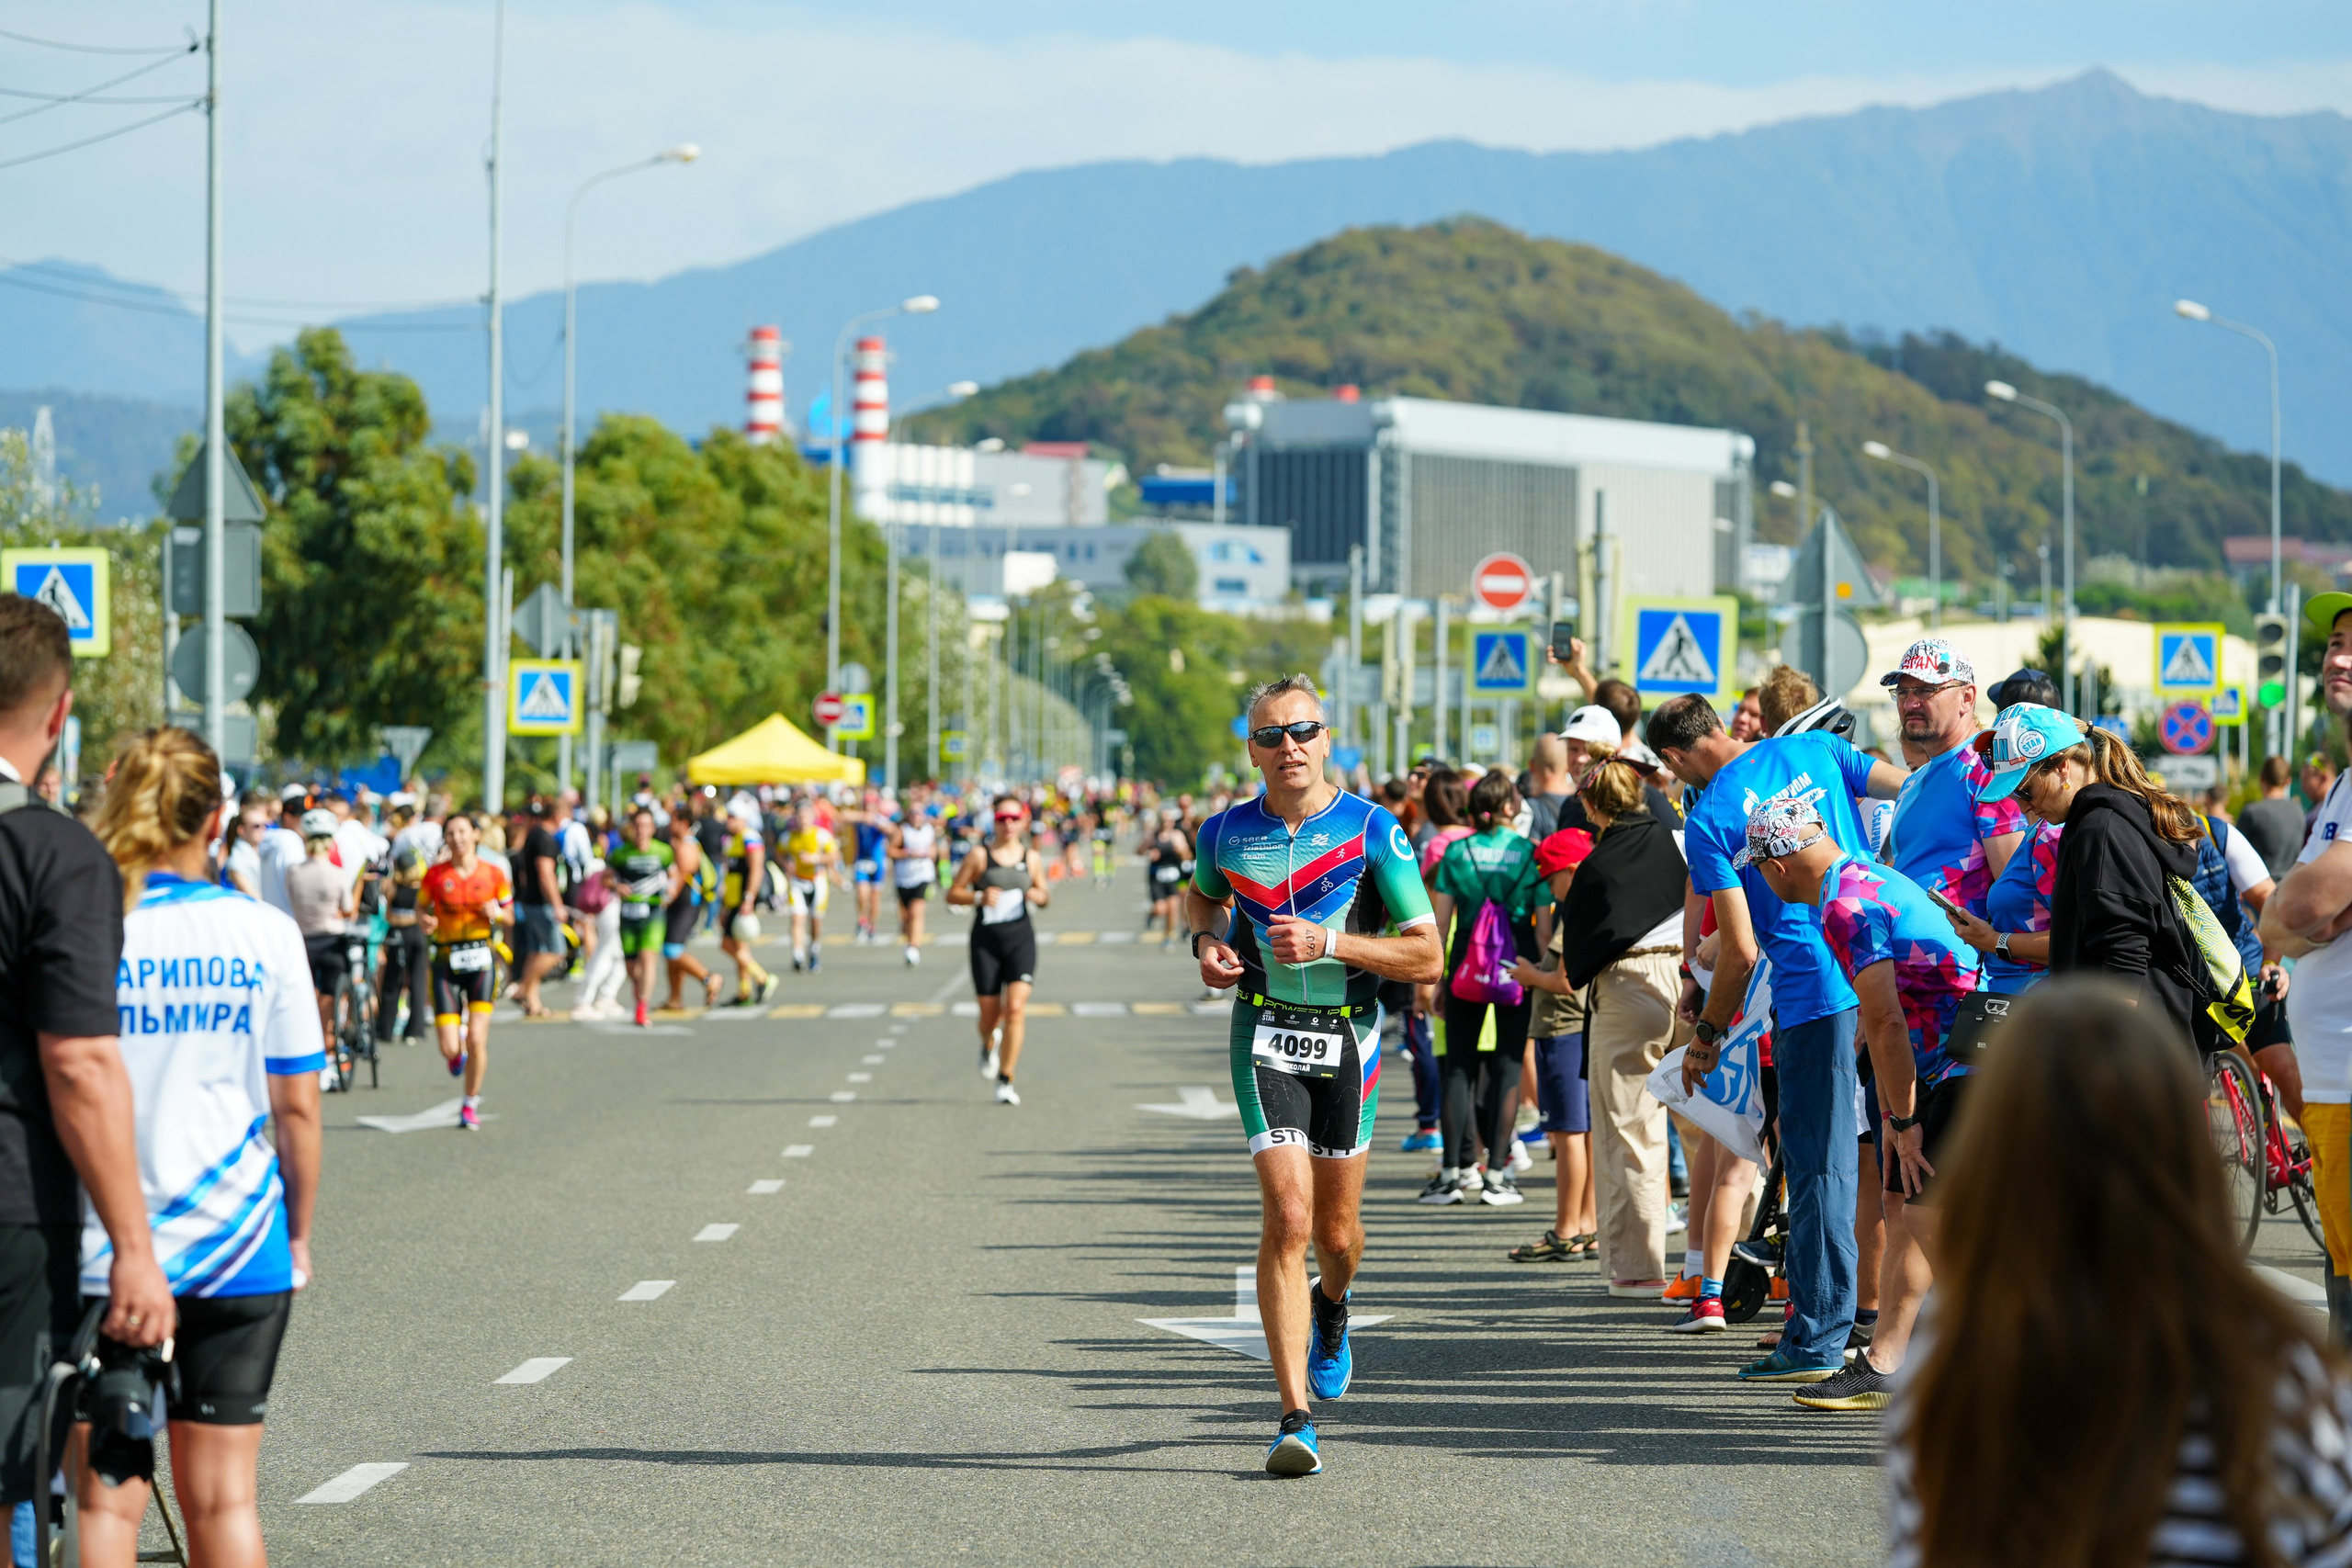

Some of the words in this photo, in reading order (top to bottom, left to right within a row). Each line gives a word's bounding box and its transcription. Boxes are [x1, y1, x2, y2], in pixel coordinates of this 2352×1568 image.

[2022, 737, 2041, 752] STAN
[1242, 835, 1268, 843] SBER
[1242, 843, 1283, 852] Triathlon
[1306, 929, 1316, 957] 4099
[115, 957, 264, 992] АРИПОВА
[118, 1003, 251, 1034] ЛЬМИРА
[1268, 1033, 1329, 1060] 4099
